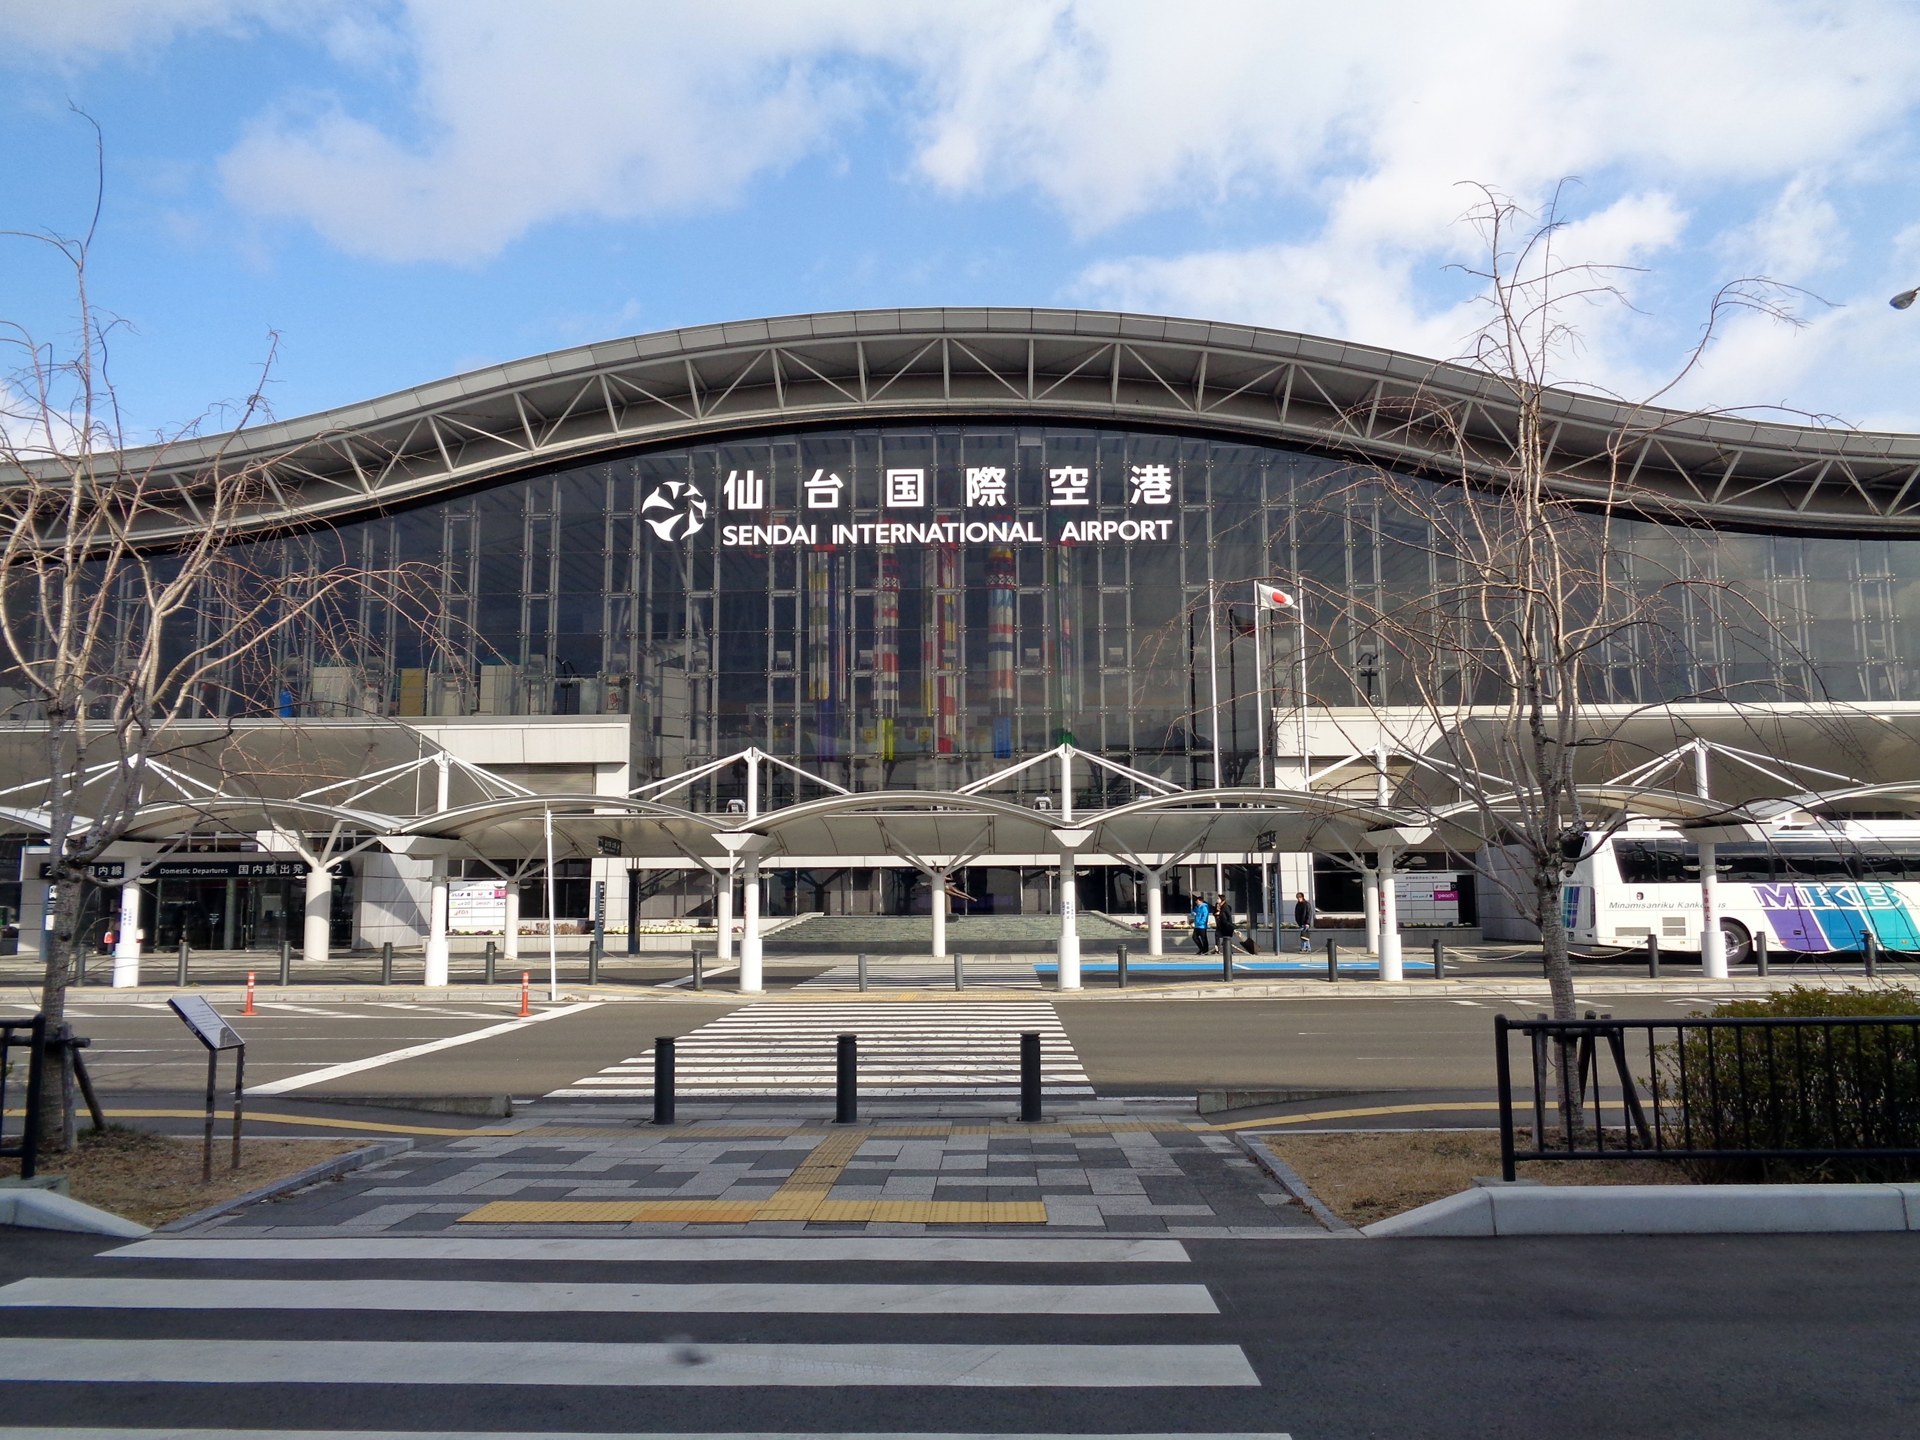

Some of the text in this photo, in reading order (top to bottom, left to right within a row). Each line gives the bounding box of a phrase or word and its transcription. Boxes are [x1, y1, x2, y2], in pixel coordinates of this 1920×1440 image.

[723, 464, 1172, 510] 仙台国際空港
[722, 520, 1173, 546] SENDAI INTERNATIONAL AIRPORT
[192, 867, 229, 875] Departures
[238, 864, 303, 875] 国内線出発
